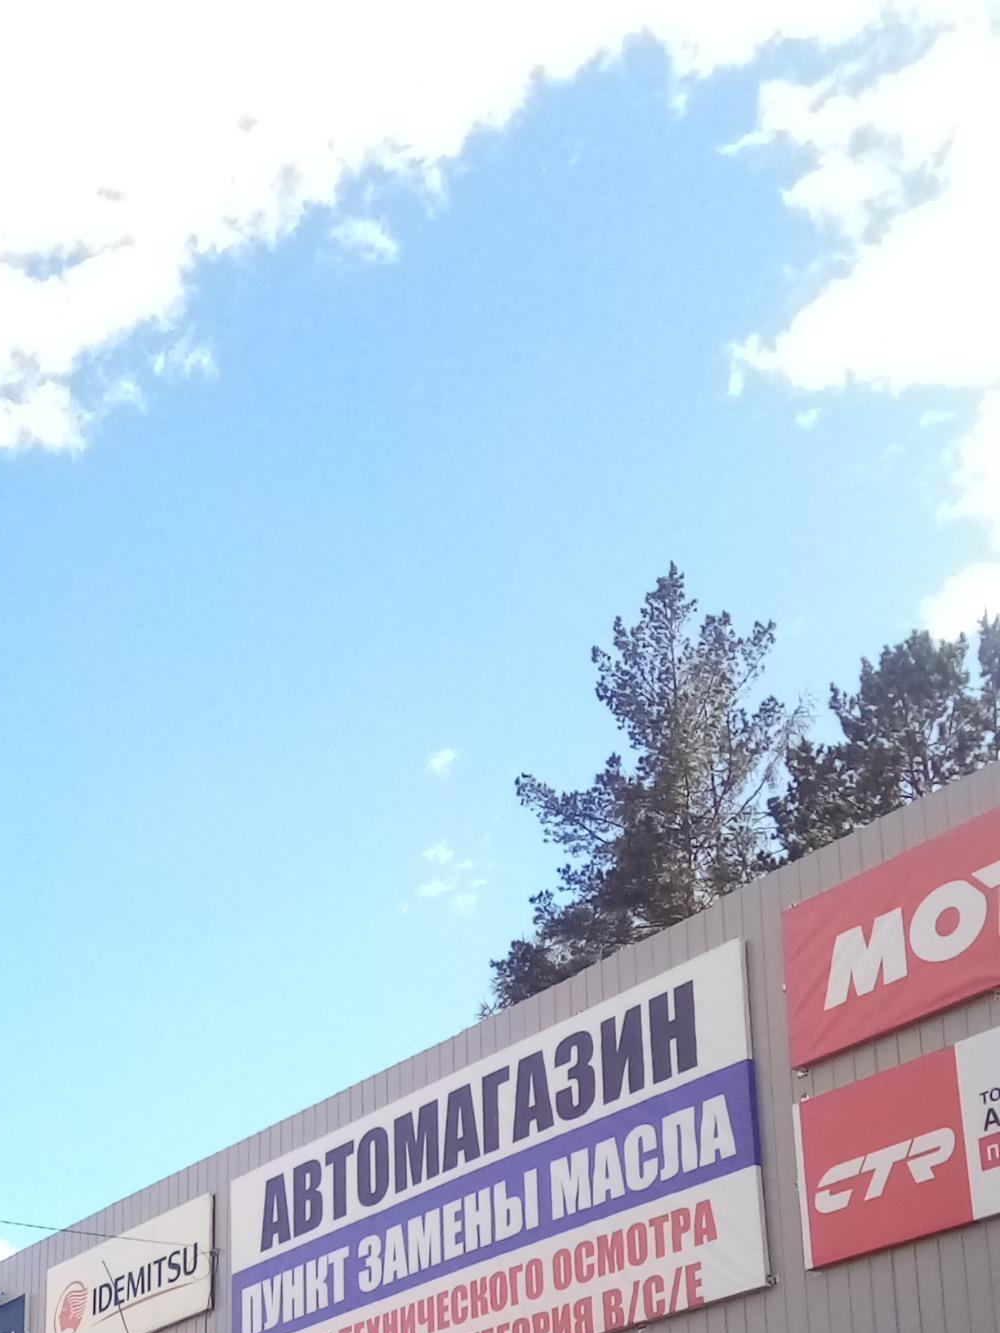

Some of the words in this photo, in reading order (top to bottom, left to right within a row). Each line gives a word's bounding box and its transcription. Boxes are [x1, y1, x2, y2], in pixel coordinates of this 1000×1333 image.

[260, 979, 698, 1253] АВТОМАГАЗИН
[357, 1167, 540, 1293] ЗАМЕНЫ
[550, 1093, 737, 1221] МАСЛА
[814, 1127, 956, 1214] CTR
[91, 1242, 199, 1316] IDEMITSU
[552, 1199, 718, 1292] ОСМОТРА
